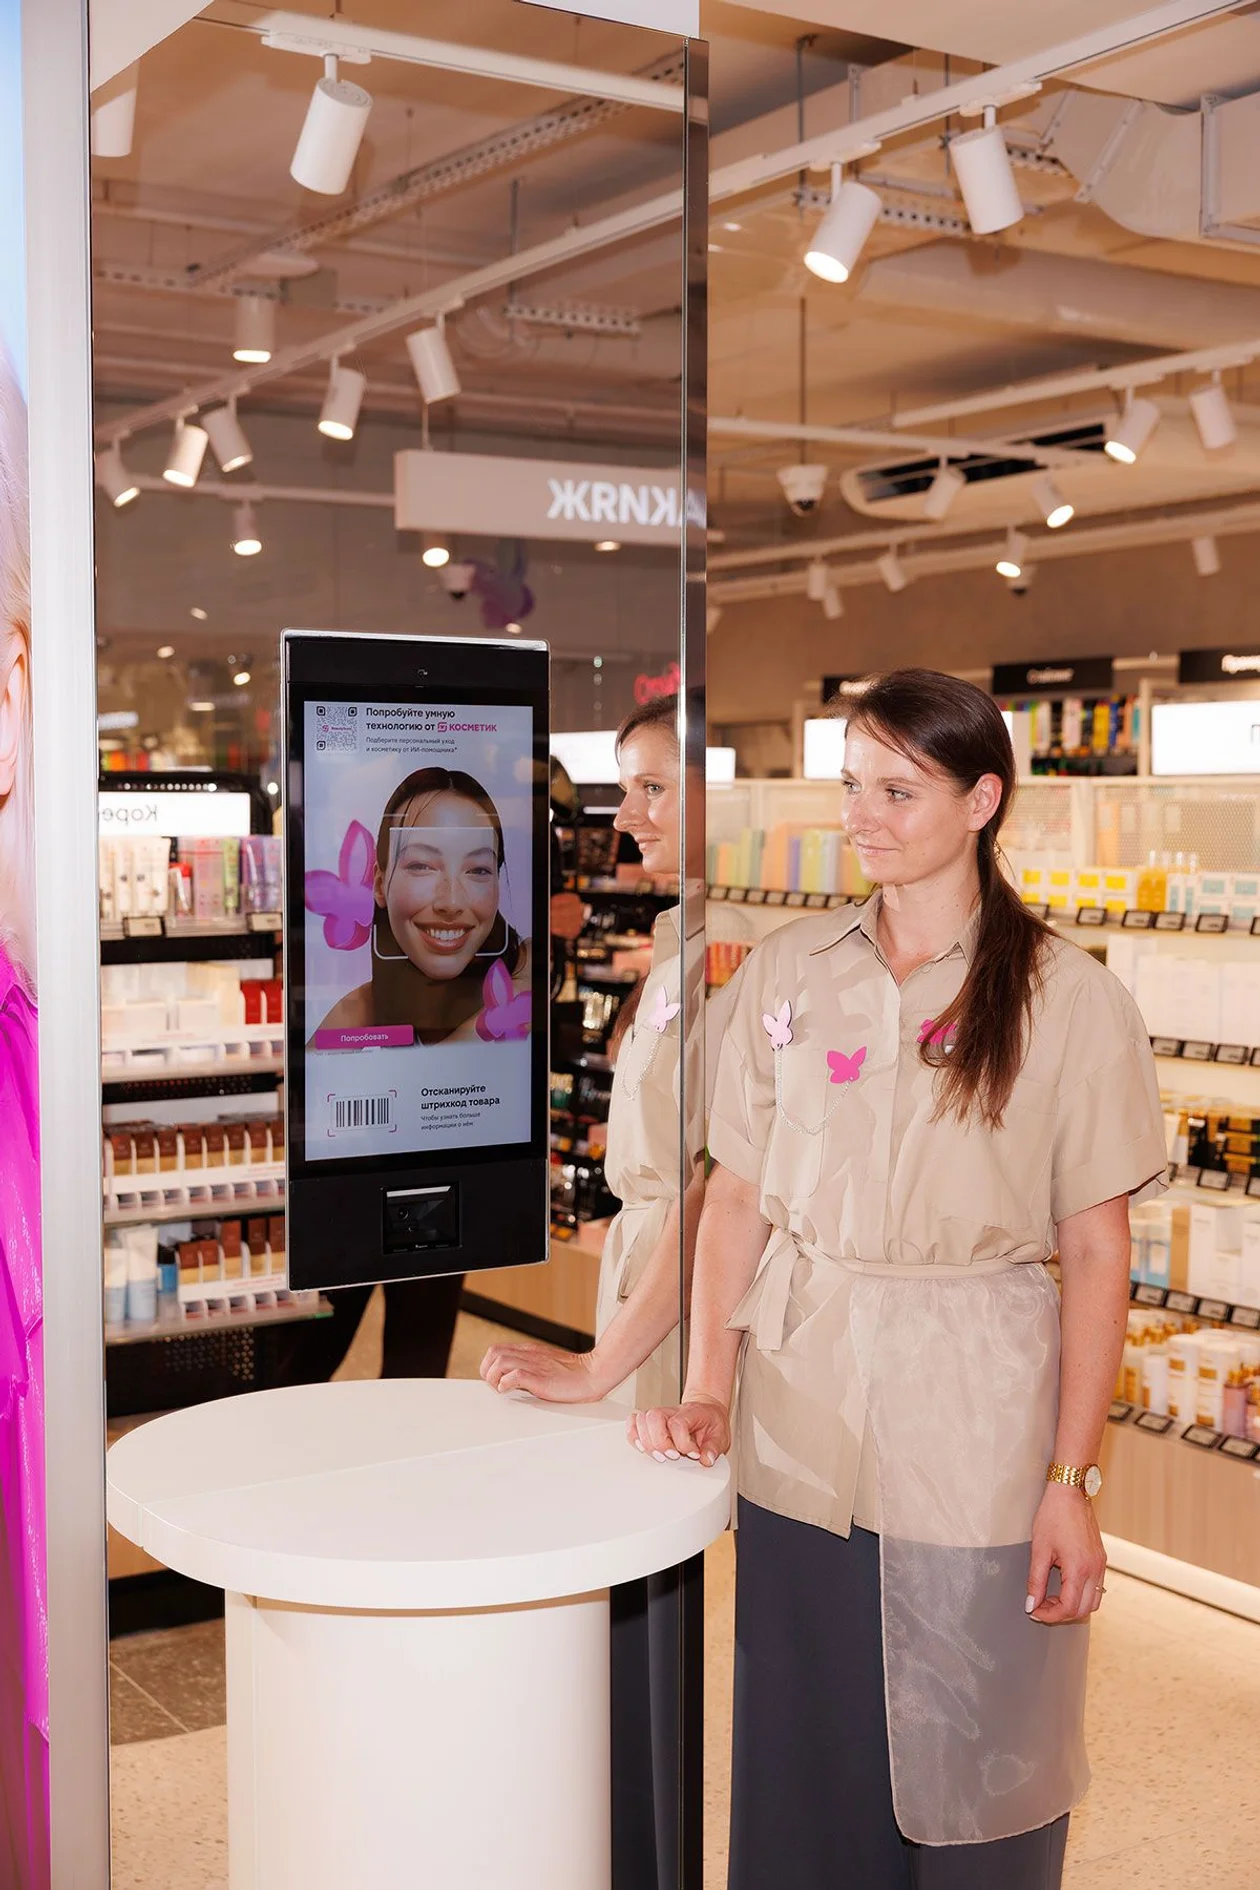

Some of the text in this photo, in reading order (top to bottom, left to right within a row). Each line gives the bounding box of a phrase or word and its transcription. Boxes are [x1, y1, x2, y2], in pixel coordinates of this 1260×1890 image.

[366, 707, 456, 720] Попробуйте умную
[366, 722, 497, 732] технологию от КОСМЕТИК
[366, 736, 398, 745] Подберите
[399, 737, 441, 746] персональный
[340, 1033, 389, 1043] Попробовать
[421, 1084, 486, 1097] Отсканируйте
[421, 1097, 500, 1110] штрихкод товара
[440, 1113, 458, 1121] узнать
[421, 1122, 457, 1130] информации
